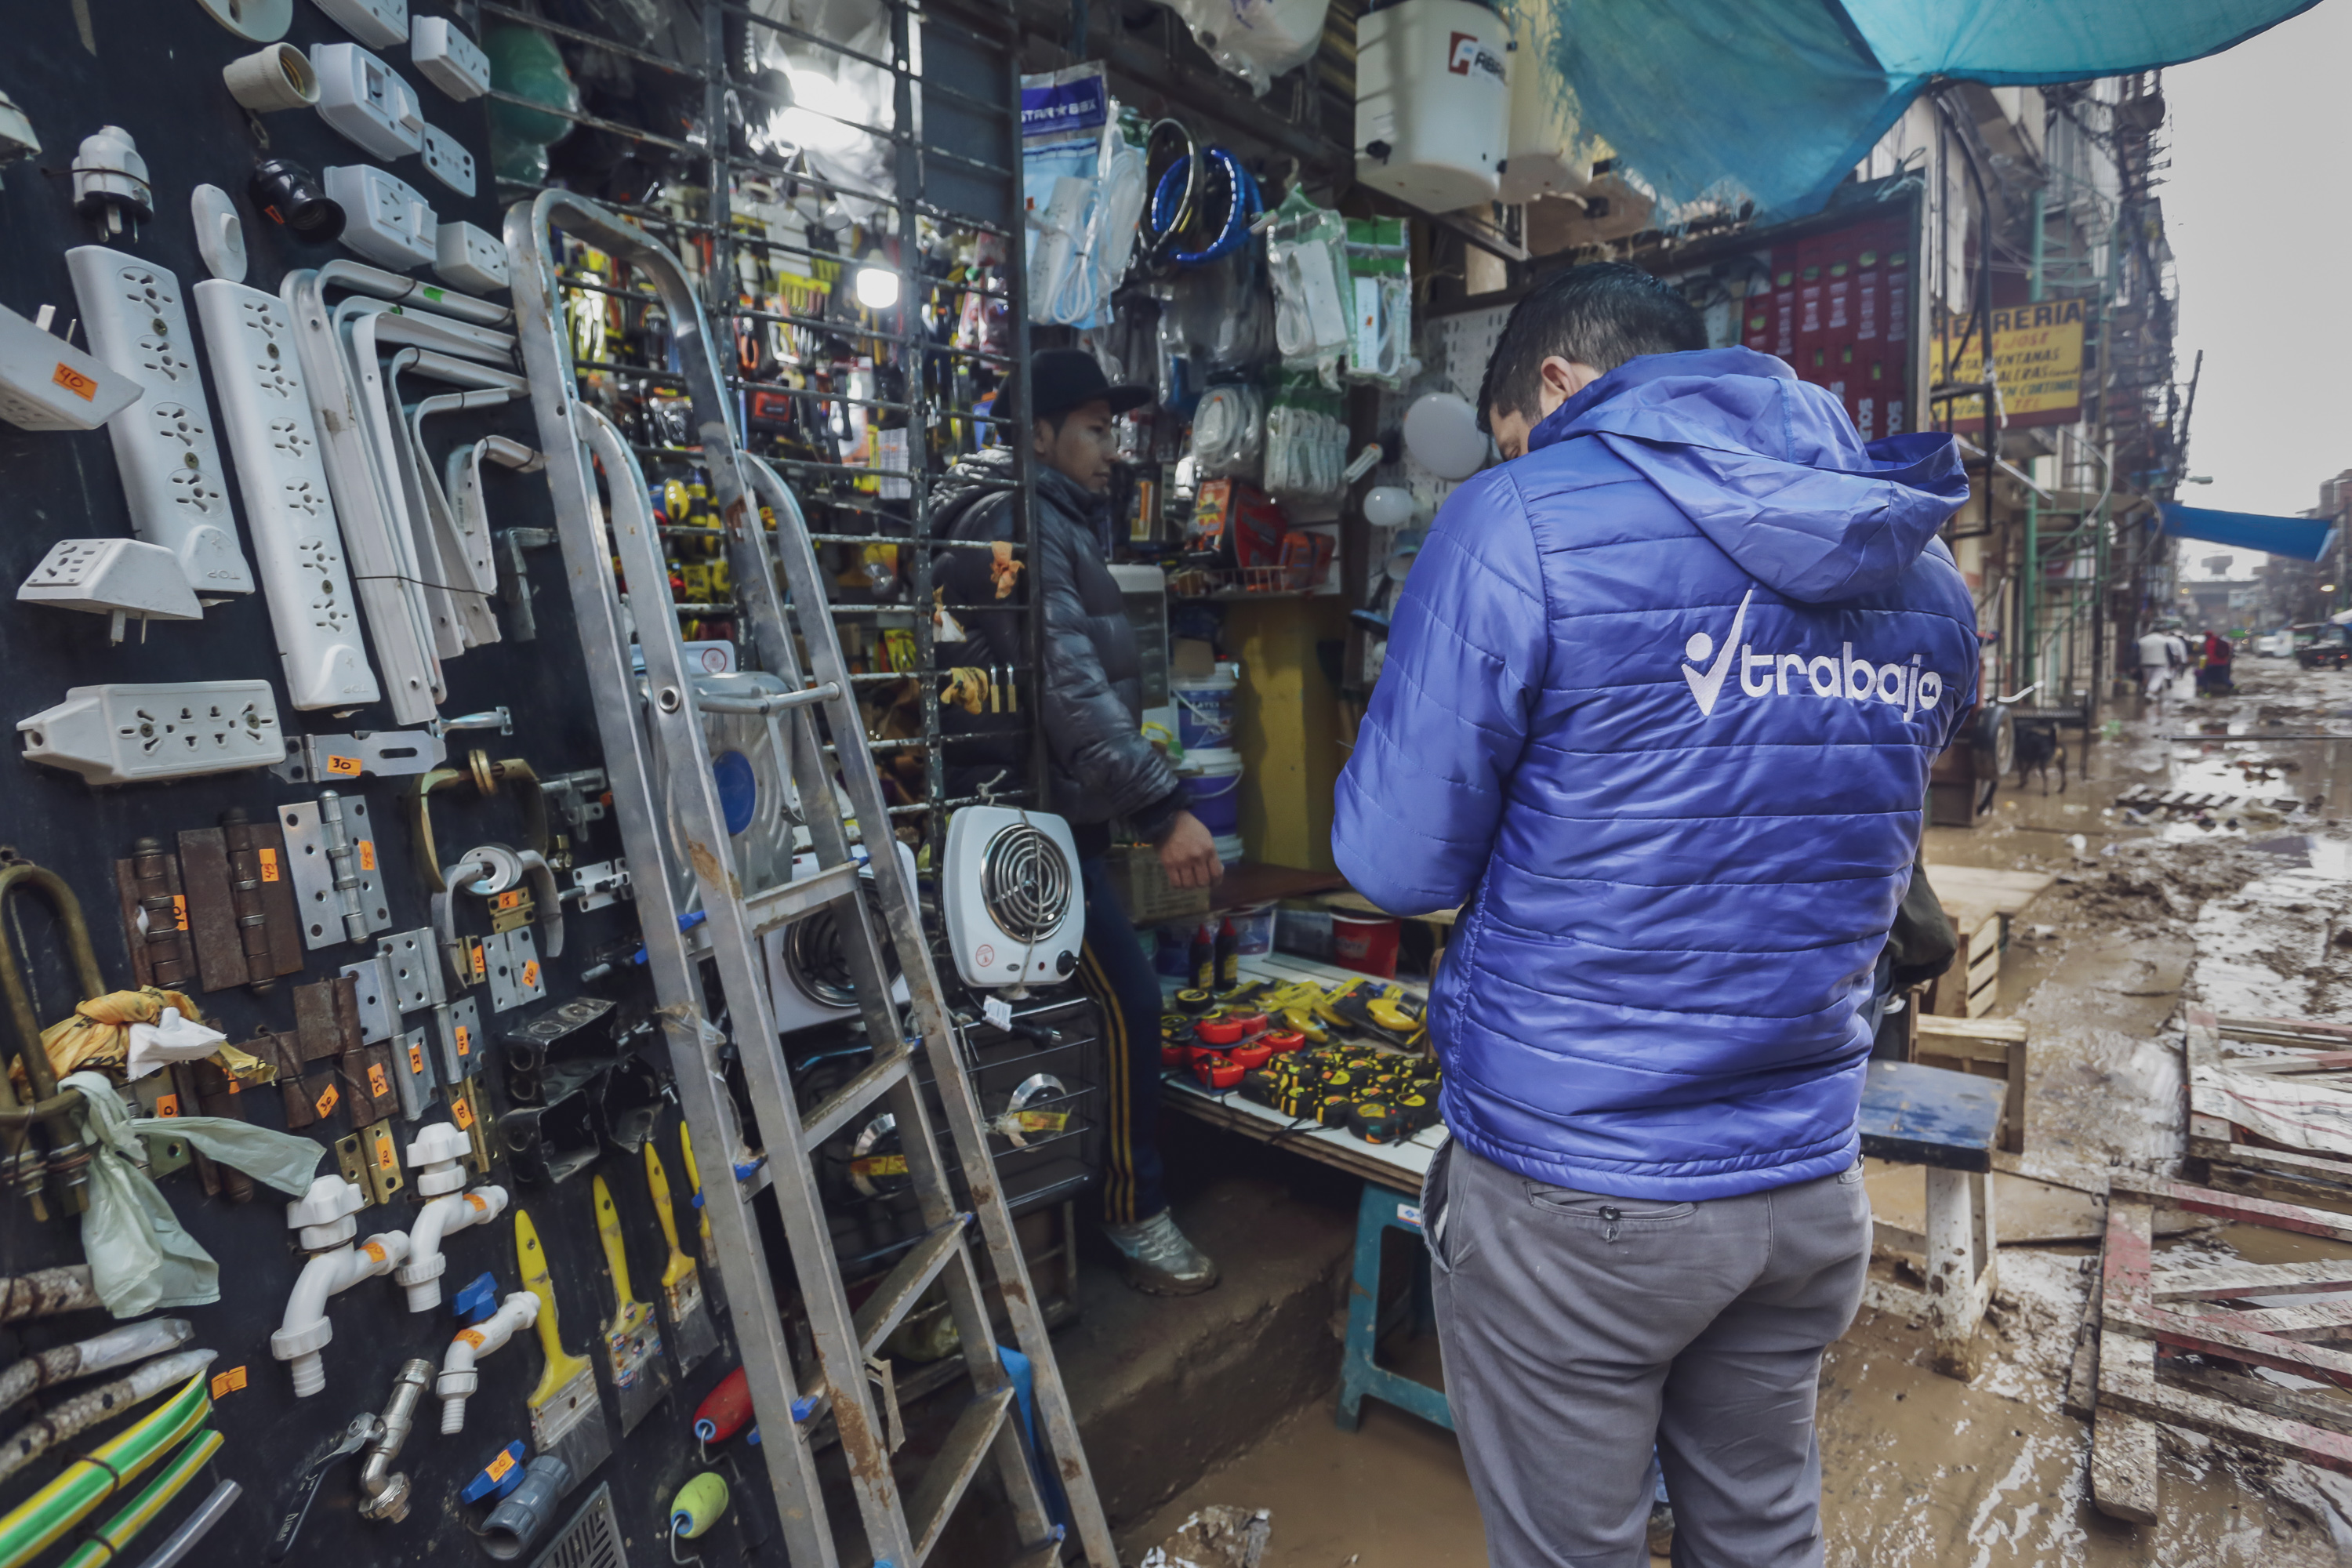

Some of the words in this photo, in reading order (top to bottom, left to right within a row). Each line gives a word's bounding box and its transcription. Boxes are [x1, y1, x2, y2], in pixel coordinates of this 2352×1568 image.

[60, 366, 84, 387] 40
[1740, 641, 1943, 723] trabajo
[332, 757, 351, 770] 30
[475, 956, 485, 969] 10
[523, 967, 534, 985] 20
[459, 1035, 466, 1051] 40
[320, 1096, 332, 1112] 30
[457, 1104, 466, 1119] 20
[383, 1149, 390, 1167] 20
